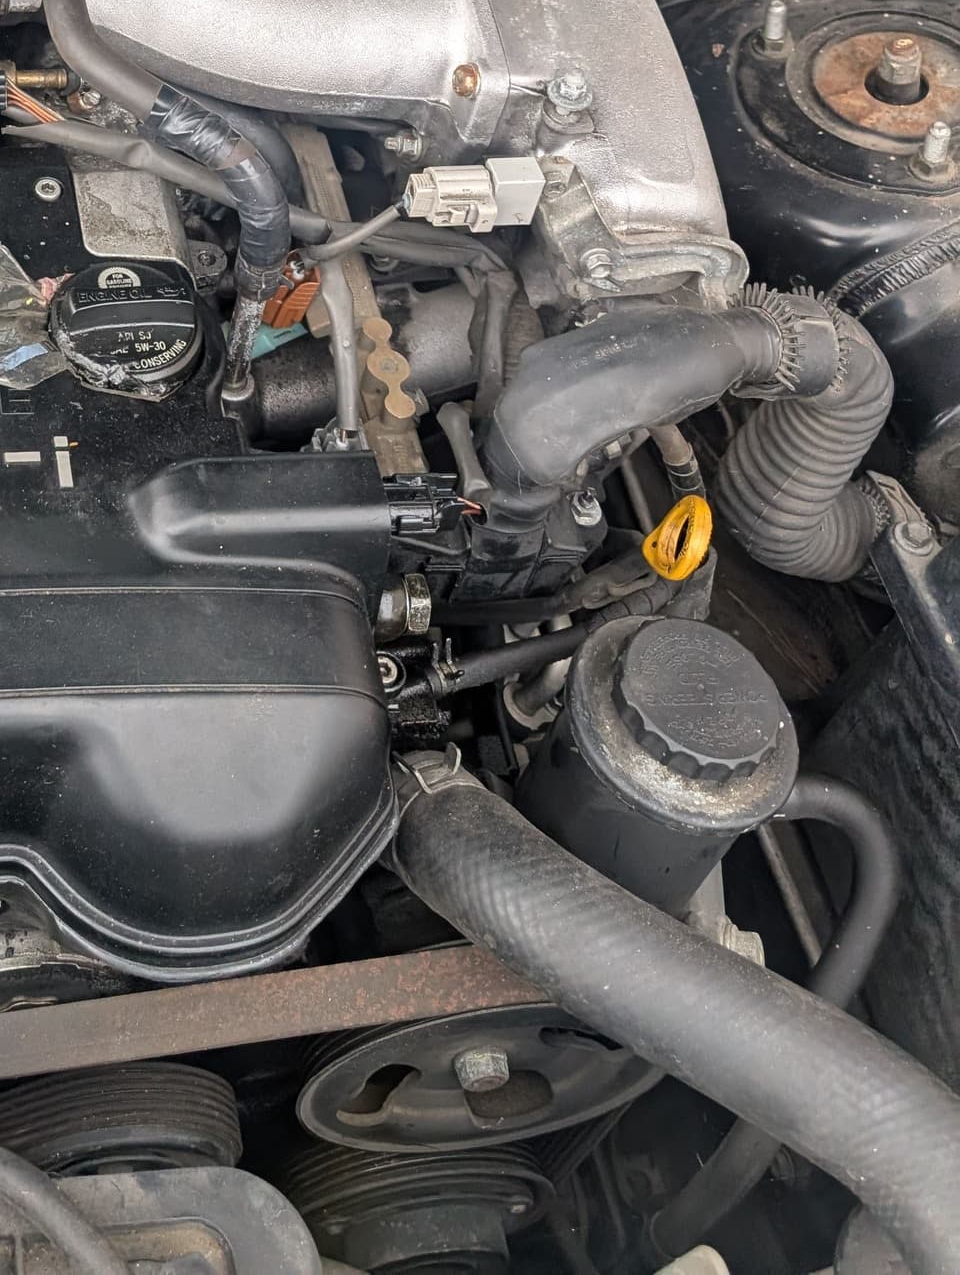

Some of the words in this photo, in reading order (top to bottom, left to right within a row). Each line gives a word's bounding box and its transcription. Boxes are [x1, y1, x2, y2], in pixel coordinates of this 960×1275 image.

[77, 289, 128, 303] ENGINE
[129, 288, 153, 299] OIL
[134, 340, 166, 353] 5W-30
